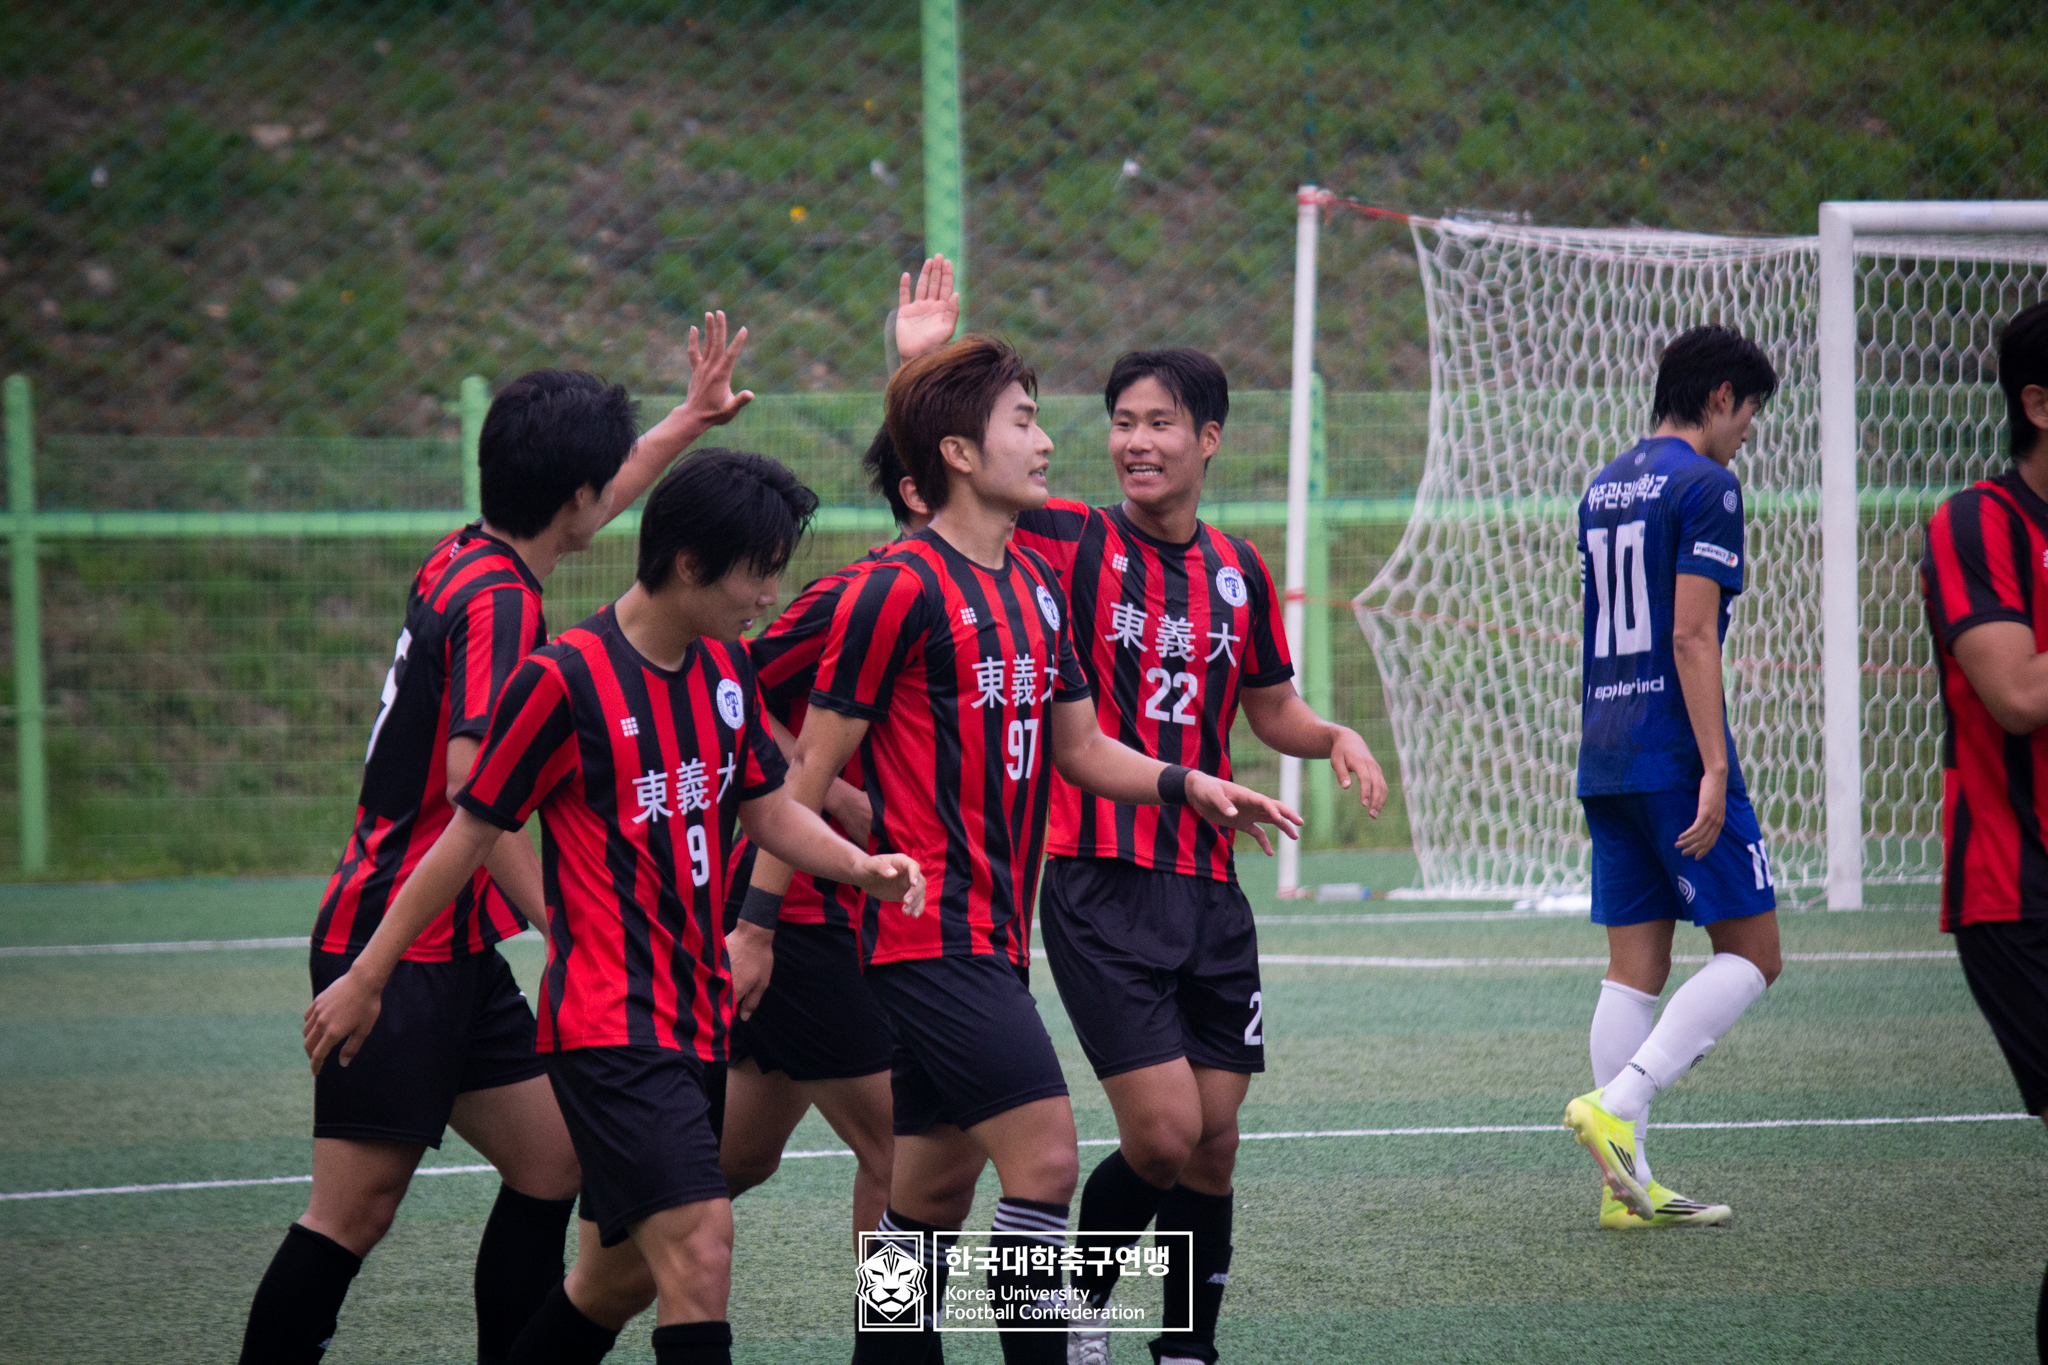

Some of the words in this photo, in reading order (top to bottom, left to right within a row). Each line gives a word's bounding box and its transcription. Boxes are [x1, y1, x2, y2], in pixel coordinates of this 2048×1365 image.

[1586, 520, 1652, 658] 10
[1104, 602, 1241, 668] 東義大
[1146, 668, 1197, 725] 22
[1007, 719, 1038, 780] 97
[687, 825, 709, 886] 9
